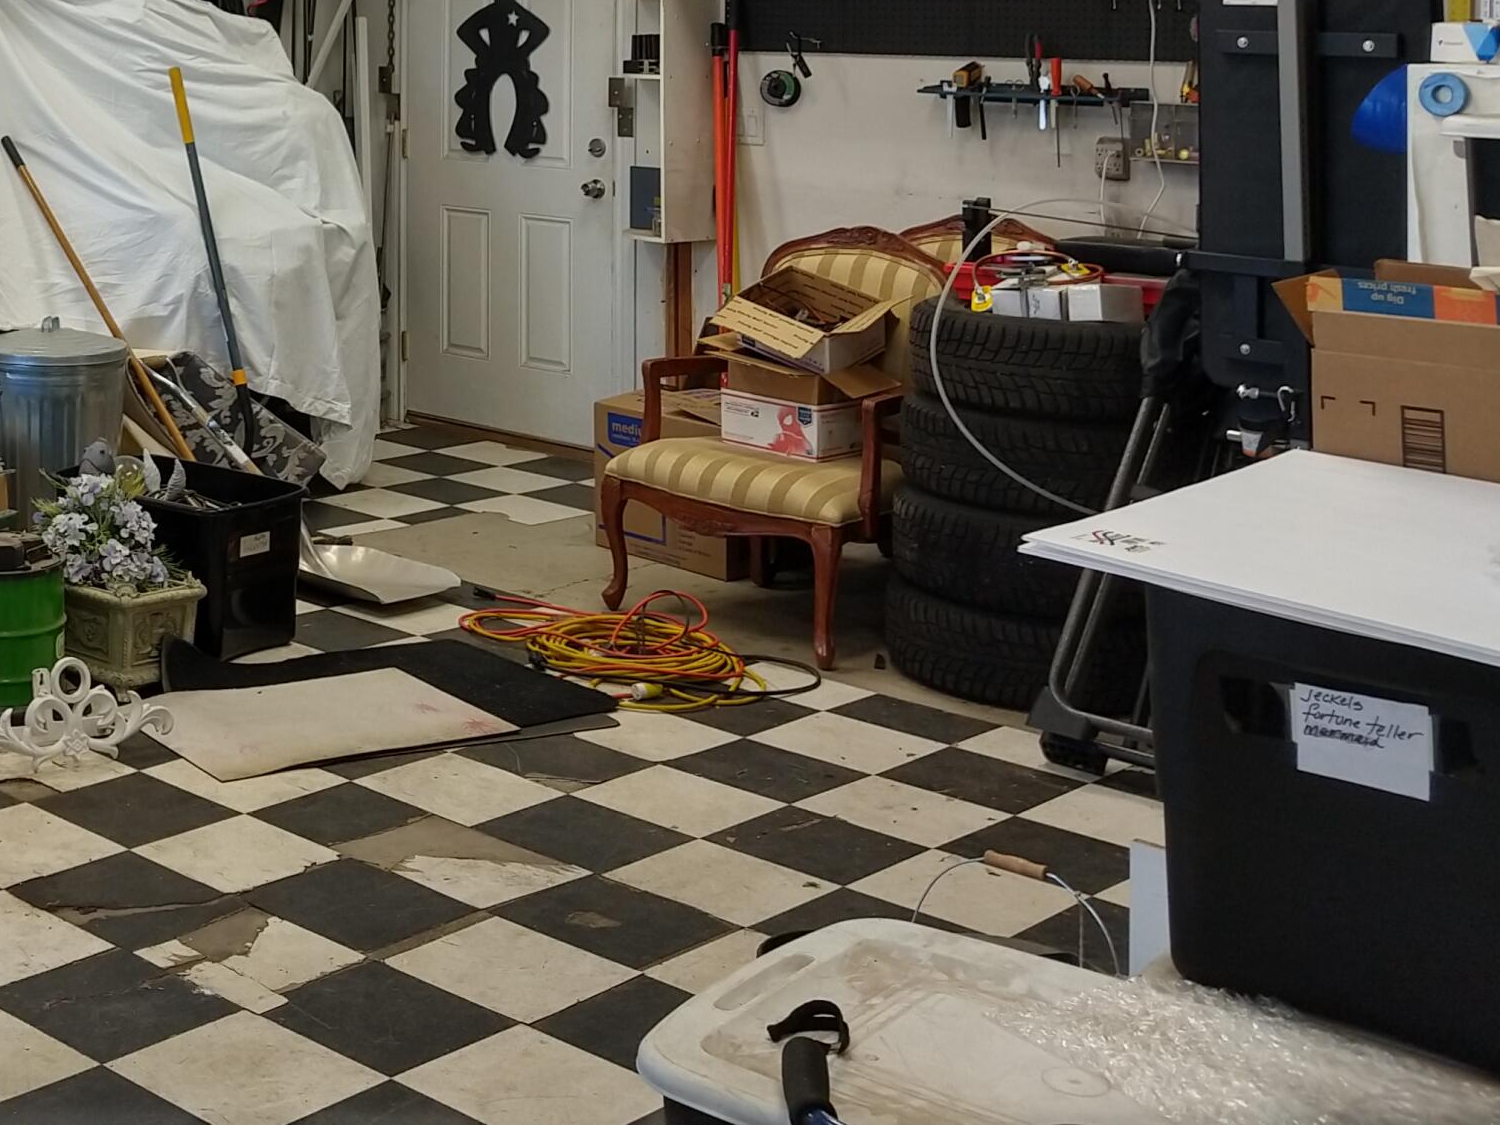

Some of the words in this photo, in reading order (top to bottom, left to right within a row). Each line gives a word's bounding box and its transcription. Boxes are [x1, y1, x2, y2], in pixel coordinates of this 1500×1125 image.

[1357, 281, 1388, 291] prices
[1390, 282, 1417, 296] fresh
[1371, 293, 1385, 302] up
[1388, 294, 1405, 305] Dig
[611, 421, 643, 437] medi
[1302, 702, 1361, 729] fortune
[1365, 715, 1425, 741] teller
